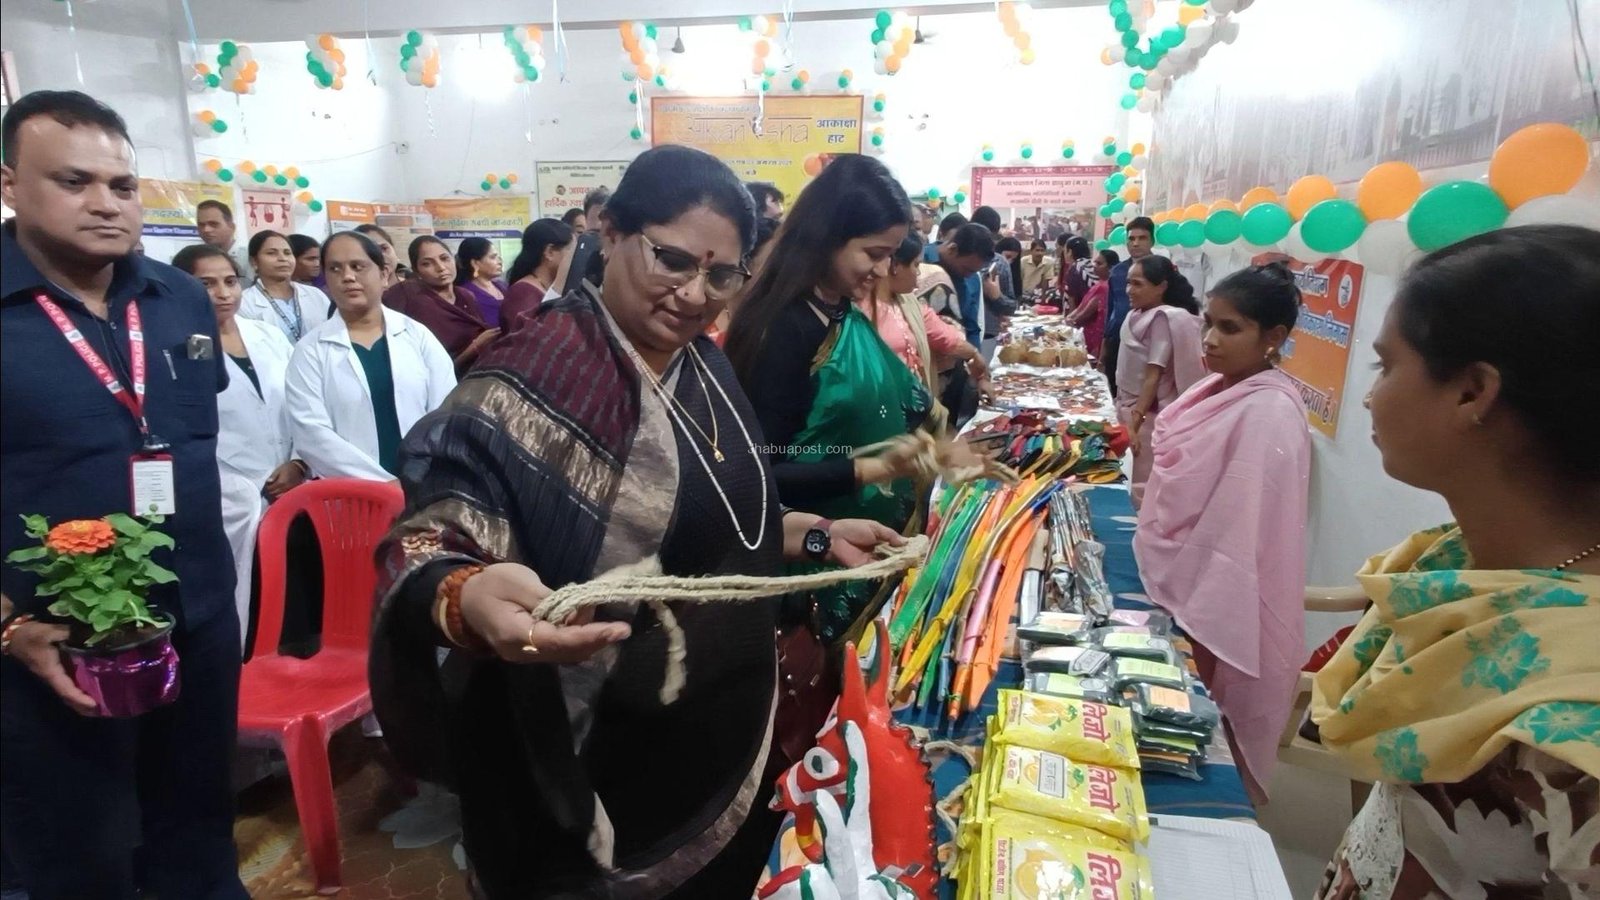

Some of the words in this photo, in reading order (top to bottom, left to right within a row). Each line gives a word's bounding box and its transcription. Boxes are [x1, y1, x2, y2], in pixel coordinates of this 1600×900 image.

[828, 134, 845, 144] हाट
[76, 340, 101, 368] POLICE
[134, 342, 142, 367] POLICE
